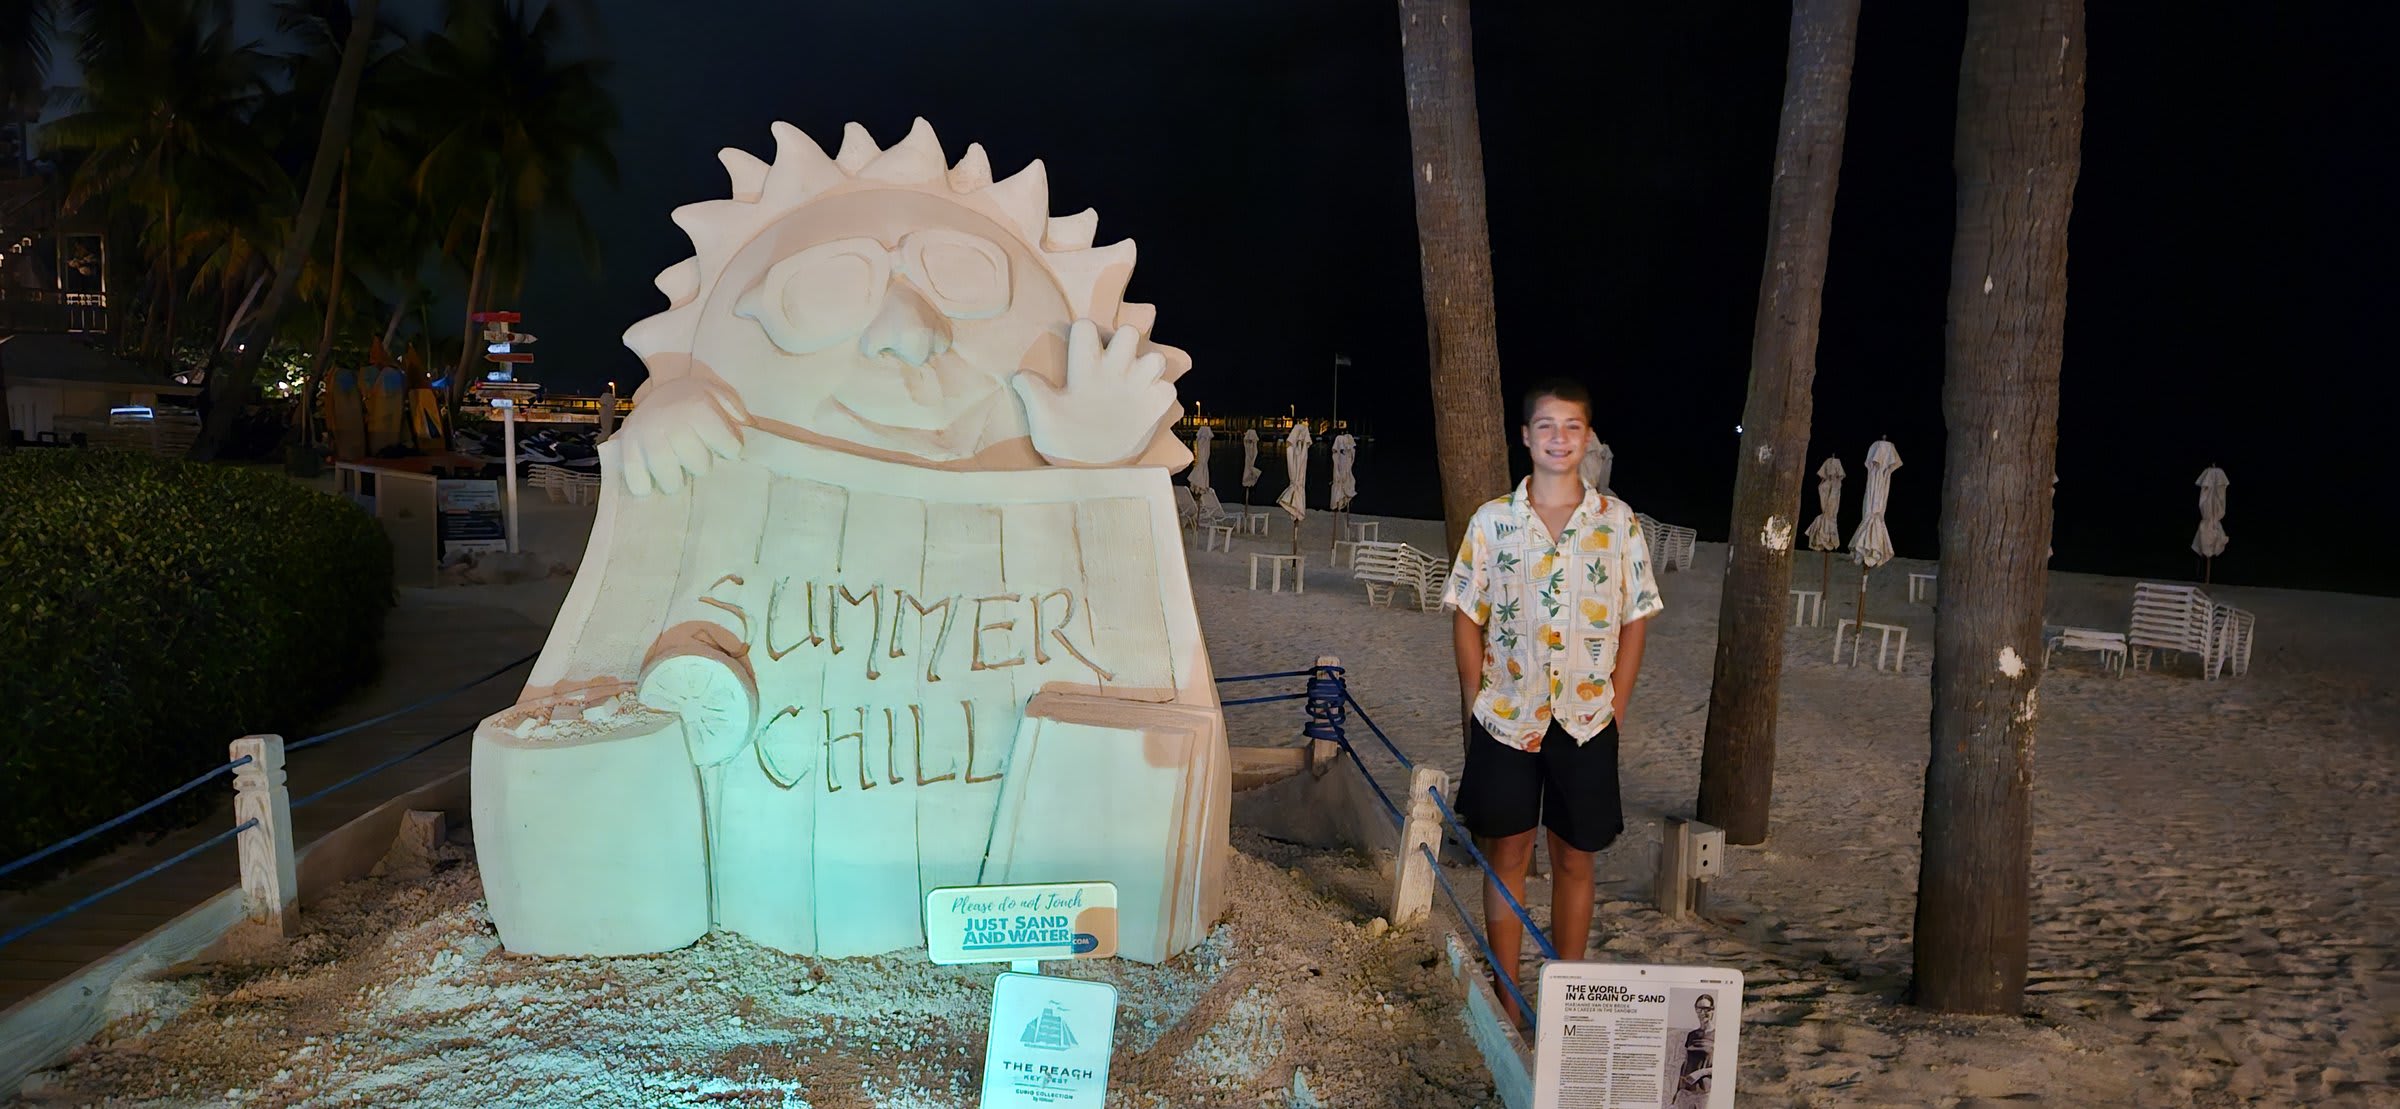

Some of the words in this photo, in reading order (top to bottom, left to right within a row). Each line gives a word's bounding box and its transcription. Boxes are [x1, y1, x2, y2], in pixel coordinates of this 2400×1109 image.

[698, 574, 1117, 682] SUMMER
[754, 699, 1004, 793] CHILL
[951, 895, 993, 914] Please
[997, 896, 1016, 912] do
[1020, 893, 1042, 911] not
[1044, 888, 1084, 910] Touch
[964, 917, 1009, 932] JUST
[1015, 915, 1069, 930] SAND
[962, 931, 1006, 945] AND
[1008, 929, 1070, 943] WATER
[1566, 984, 1587, 993] THE
[1588, 985, 1628, 994] WORLD
[1565, 992, 1576, 1001] IN
[1577, 992, 1586, 1001] A
[1587, 992, 1619, 1002] GRAIN
[1622, 994, 1636, 1003] OF
[1637, 994, 1666, 1004] SAND
[1003, 1061, 1034, 1073] THE
[1039, 1065, 1093, 1079] REACH
[1036, 1090, 1074, 1100] COLLECTION
